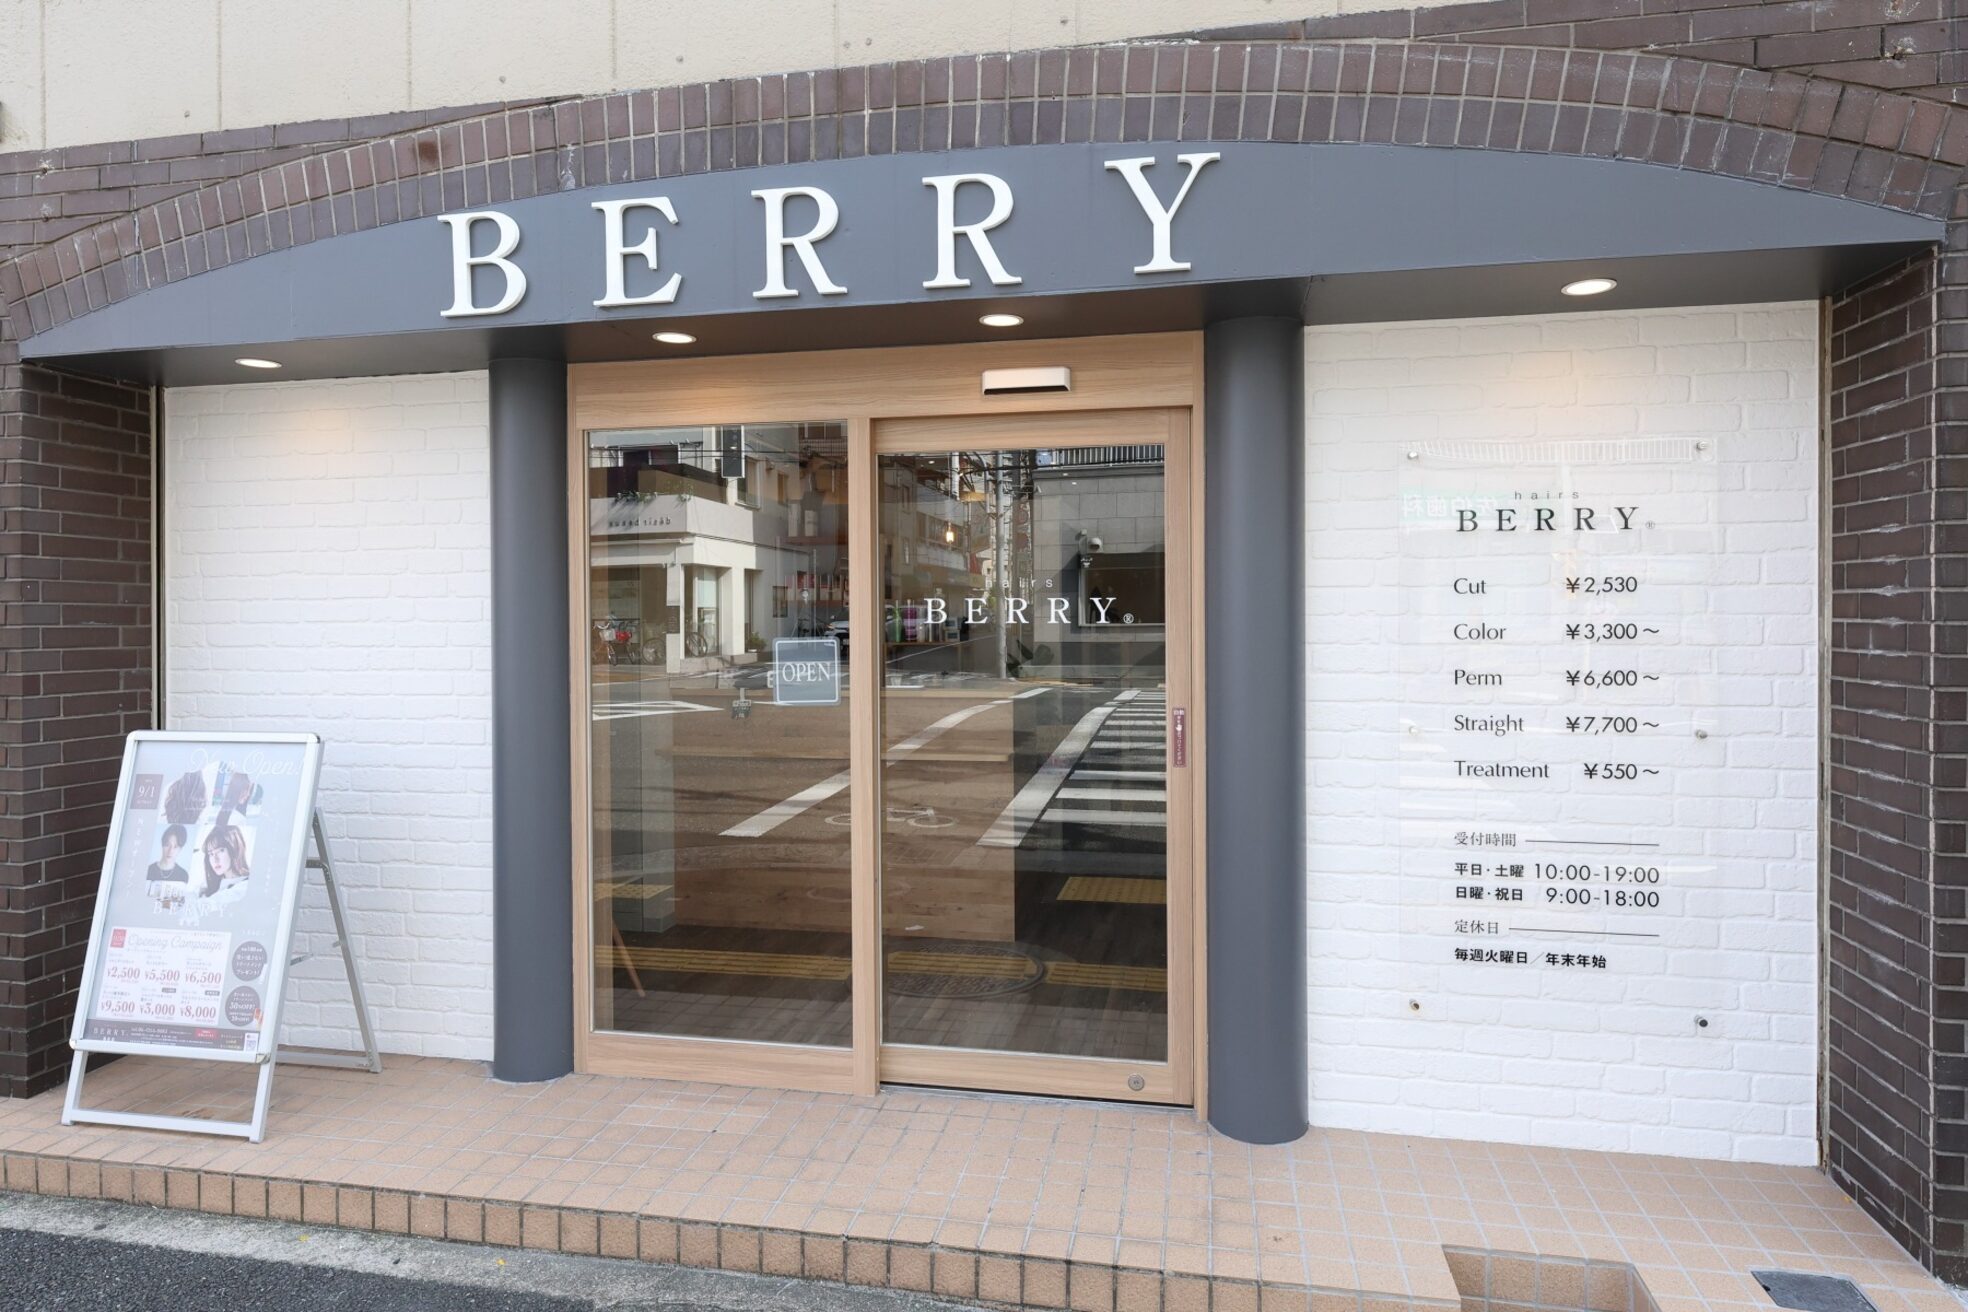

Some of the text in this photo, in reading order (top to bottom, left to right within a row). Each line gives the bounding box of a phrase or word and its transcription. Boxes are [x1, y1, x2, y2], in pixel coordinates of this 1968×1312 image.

[436, 151, 1221, 319] BERRY
[1514, 490, 1579, 500] hairs
[1453, 576, 1638, 595] Cut ¥2,530
[1453, 622, 1507, 641] Color
[782, 662, 831, 682] OPEN
[1454, 669, 1502, 686] Perm
[1454, 714, 1524, 737] Straight
[1454, 760, 1550, 779] Treatment
[1454, 832, 1517, 847] 受付時間
[1454, 863, 1660, 884] 平日・土曜 10:00-19:00
[1455, 886, 1660, 908] 日曜・祝日 9:00-18:00
[1454, 919, 1499, 935] 定休日
